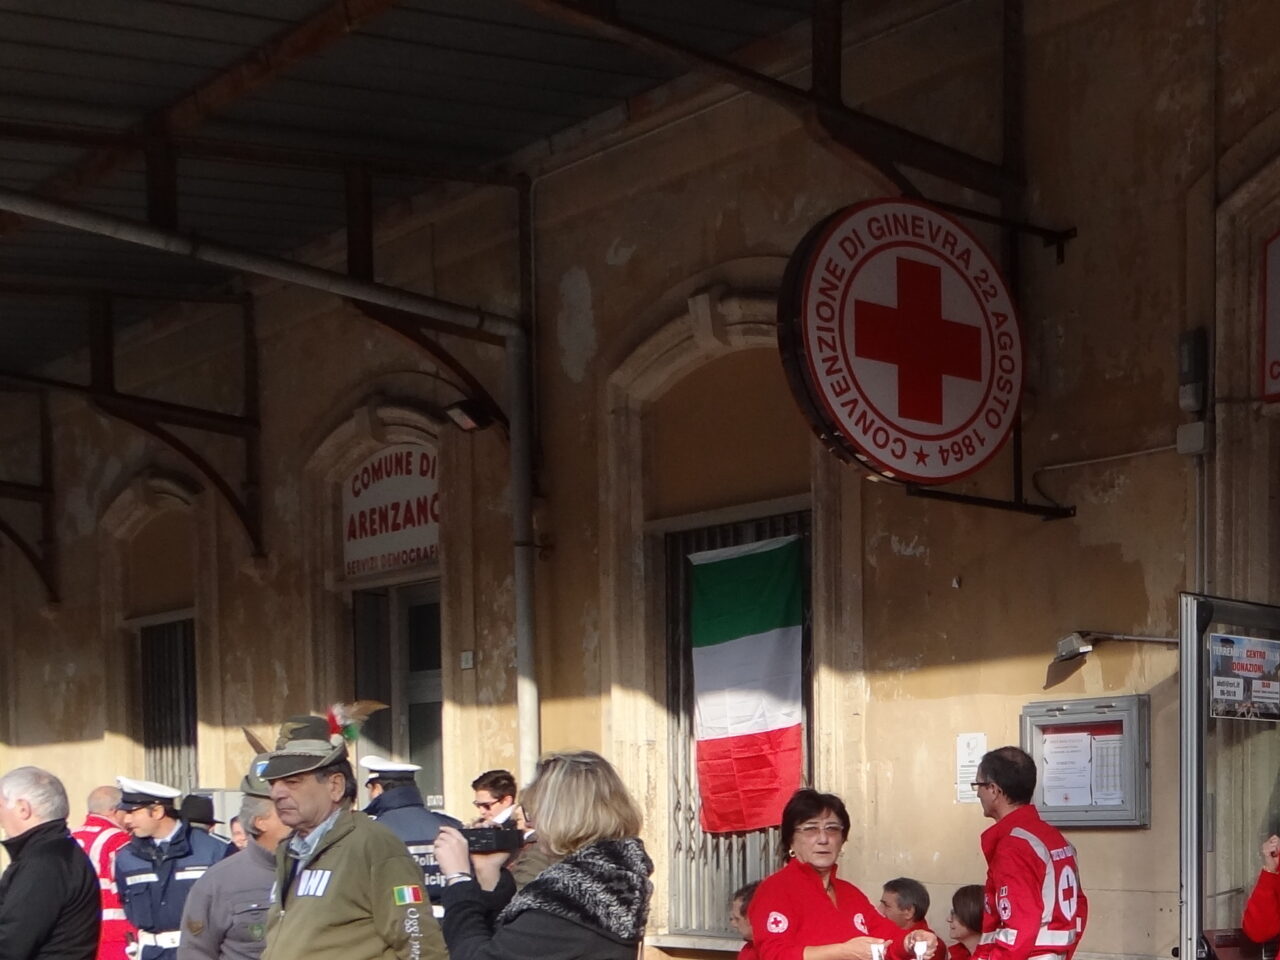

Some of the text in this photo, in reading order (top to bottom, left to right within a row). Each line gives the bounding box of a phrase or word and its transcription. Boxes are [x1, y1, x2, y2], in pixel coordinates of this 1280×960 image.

[815, 213, 1015, 466] CONVENZIONE DI GINEVRA 22 AGOSTO 1864
[351, 451, 437, 498] COMUNE DI
[346, 556, 379, 575] SERVIZI
[404, 907, 424, 938] Oggi
